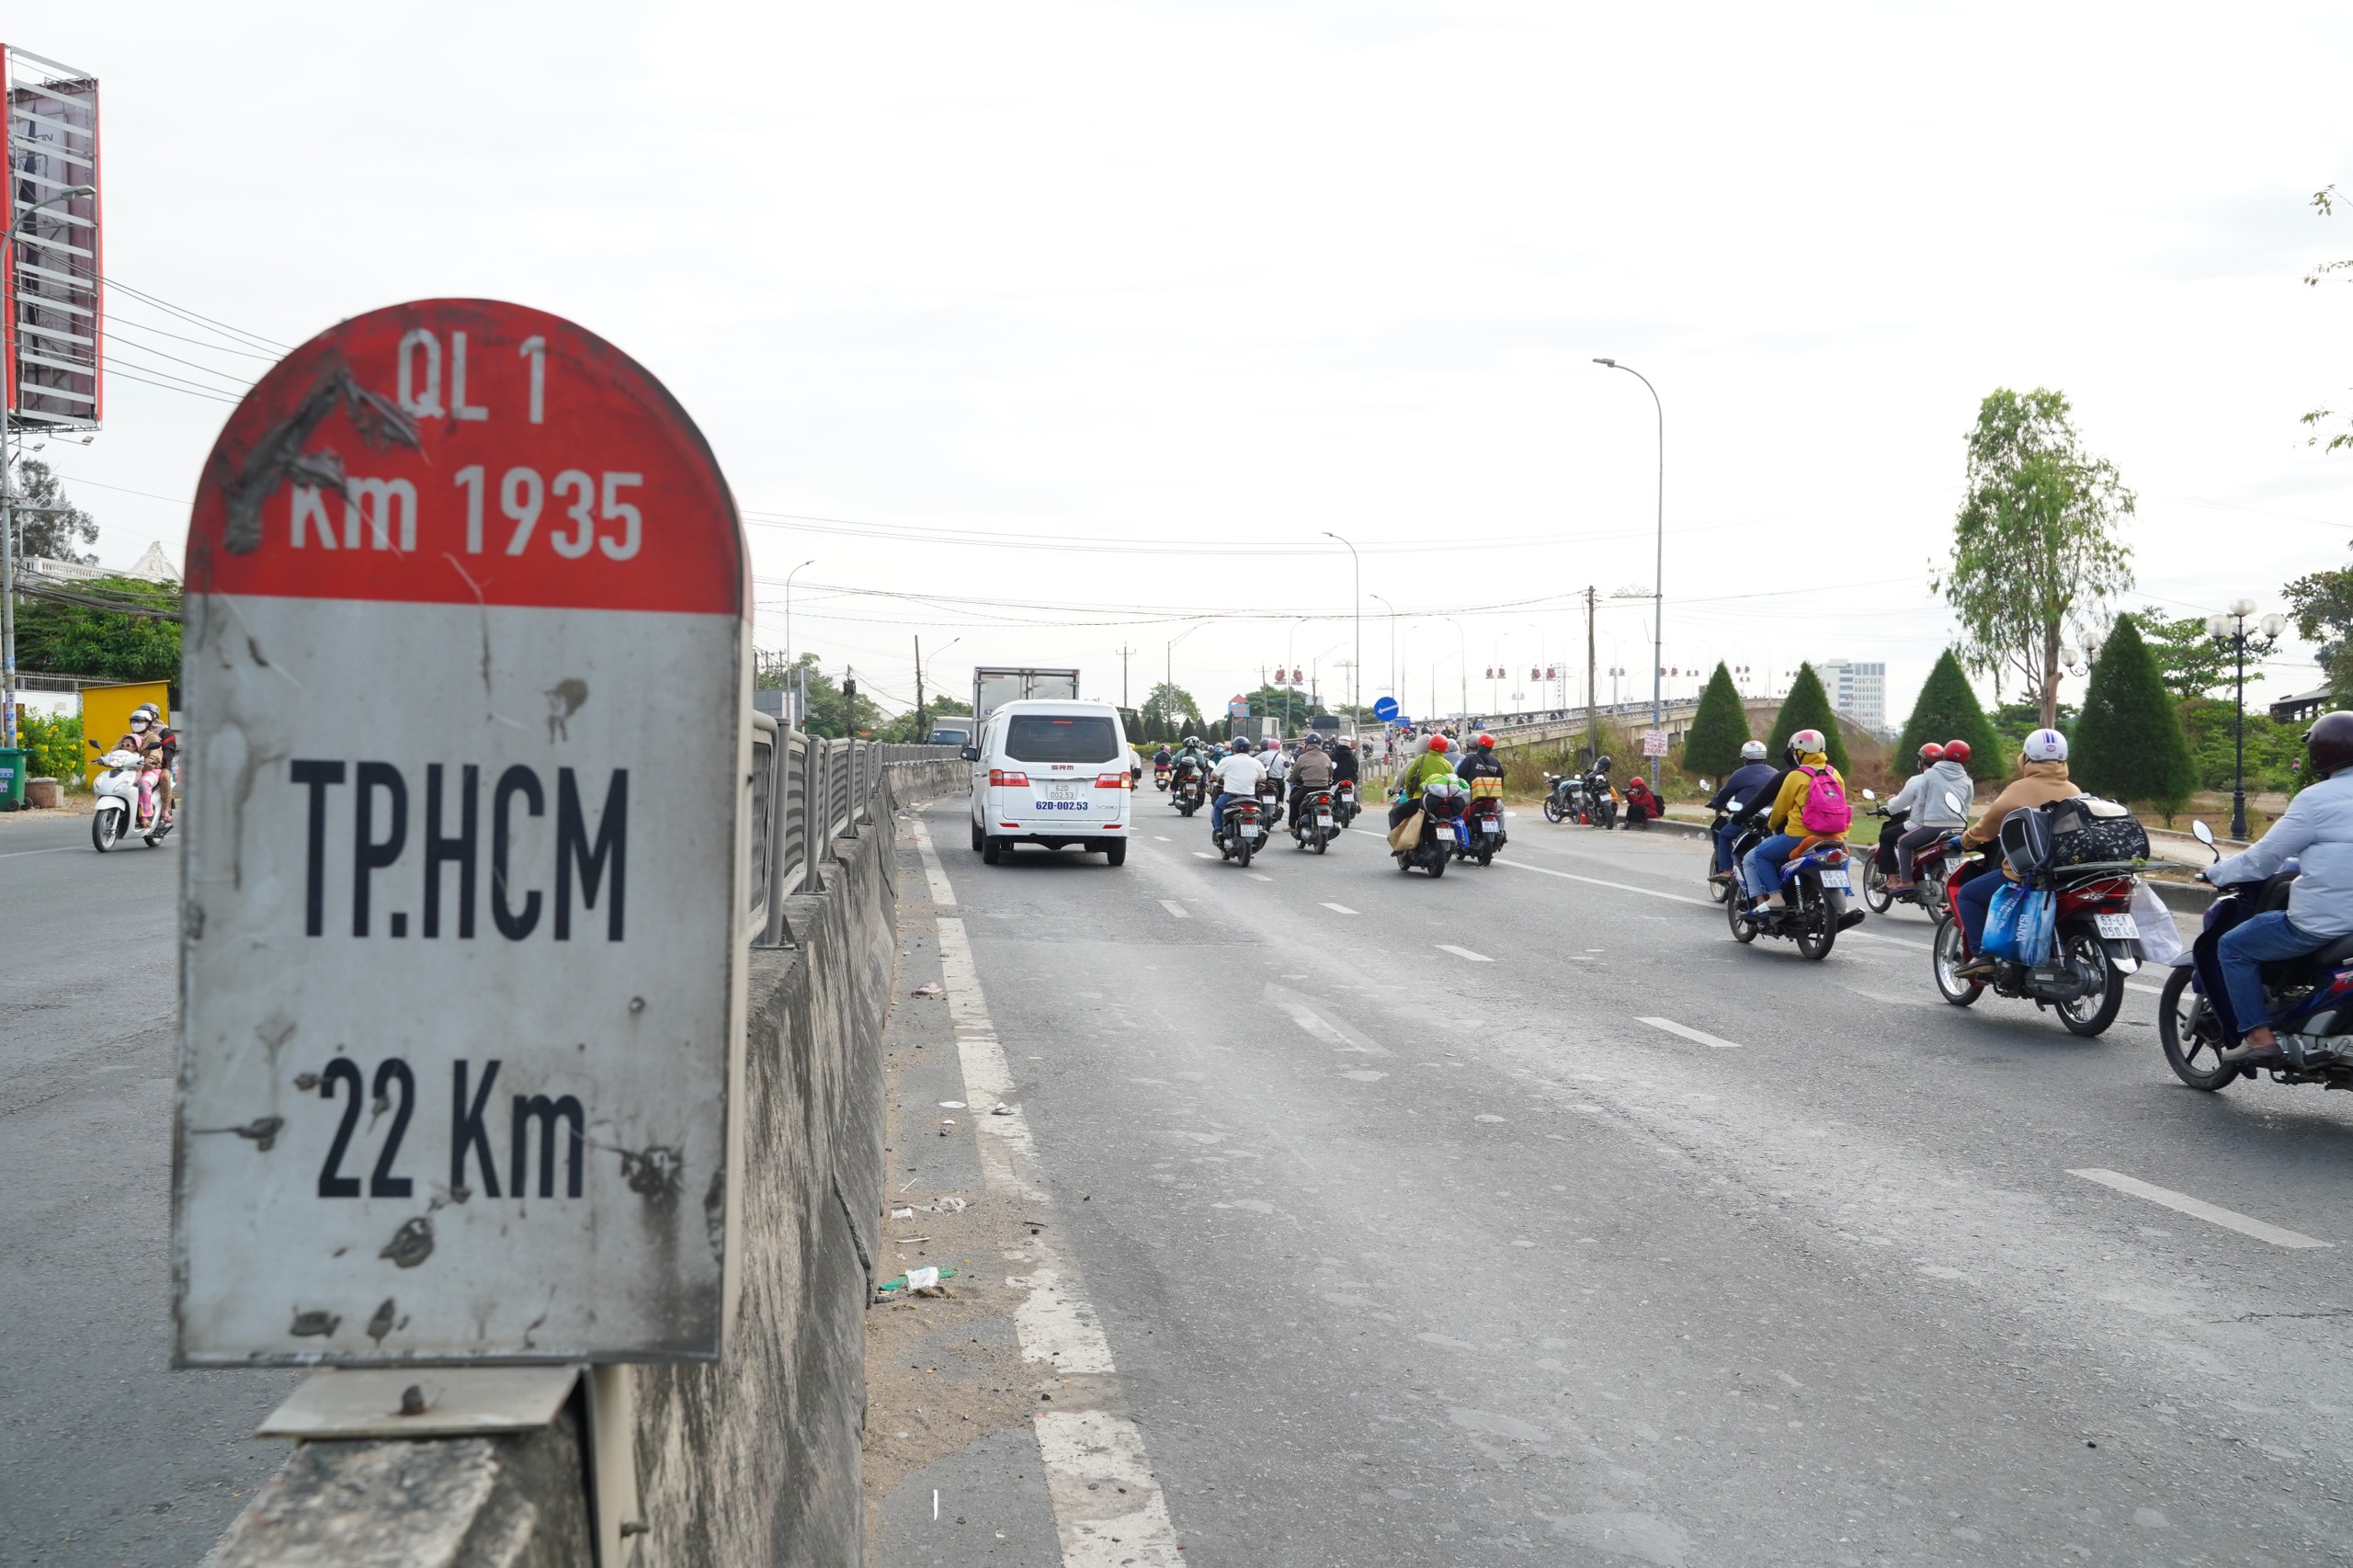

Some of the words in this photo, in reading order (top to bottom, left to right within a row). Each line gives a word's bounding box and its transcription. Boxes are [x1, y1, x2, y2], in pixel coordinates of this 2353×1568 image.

[396, 327, 489, 422] QL
[518, 335, 546, 425] 1
[290, 475, 418, 553] Km
[454, 465, 643, 562] 1935
[1036, 801, 1088, 810] 62D-002.53
[290, 759, 629, 942] TP.HCM
[2016, 914, 2029, 942] ISANA
[2100, 915, 2126, 926] 63-C1
[2101, 926, 2136, 937] 050.49
[317, 1057, 415, 1199] 22
[450, 1059, 585, 1199] Km
